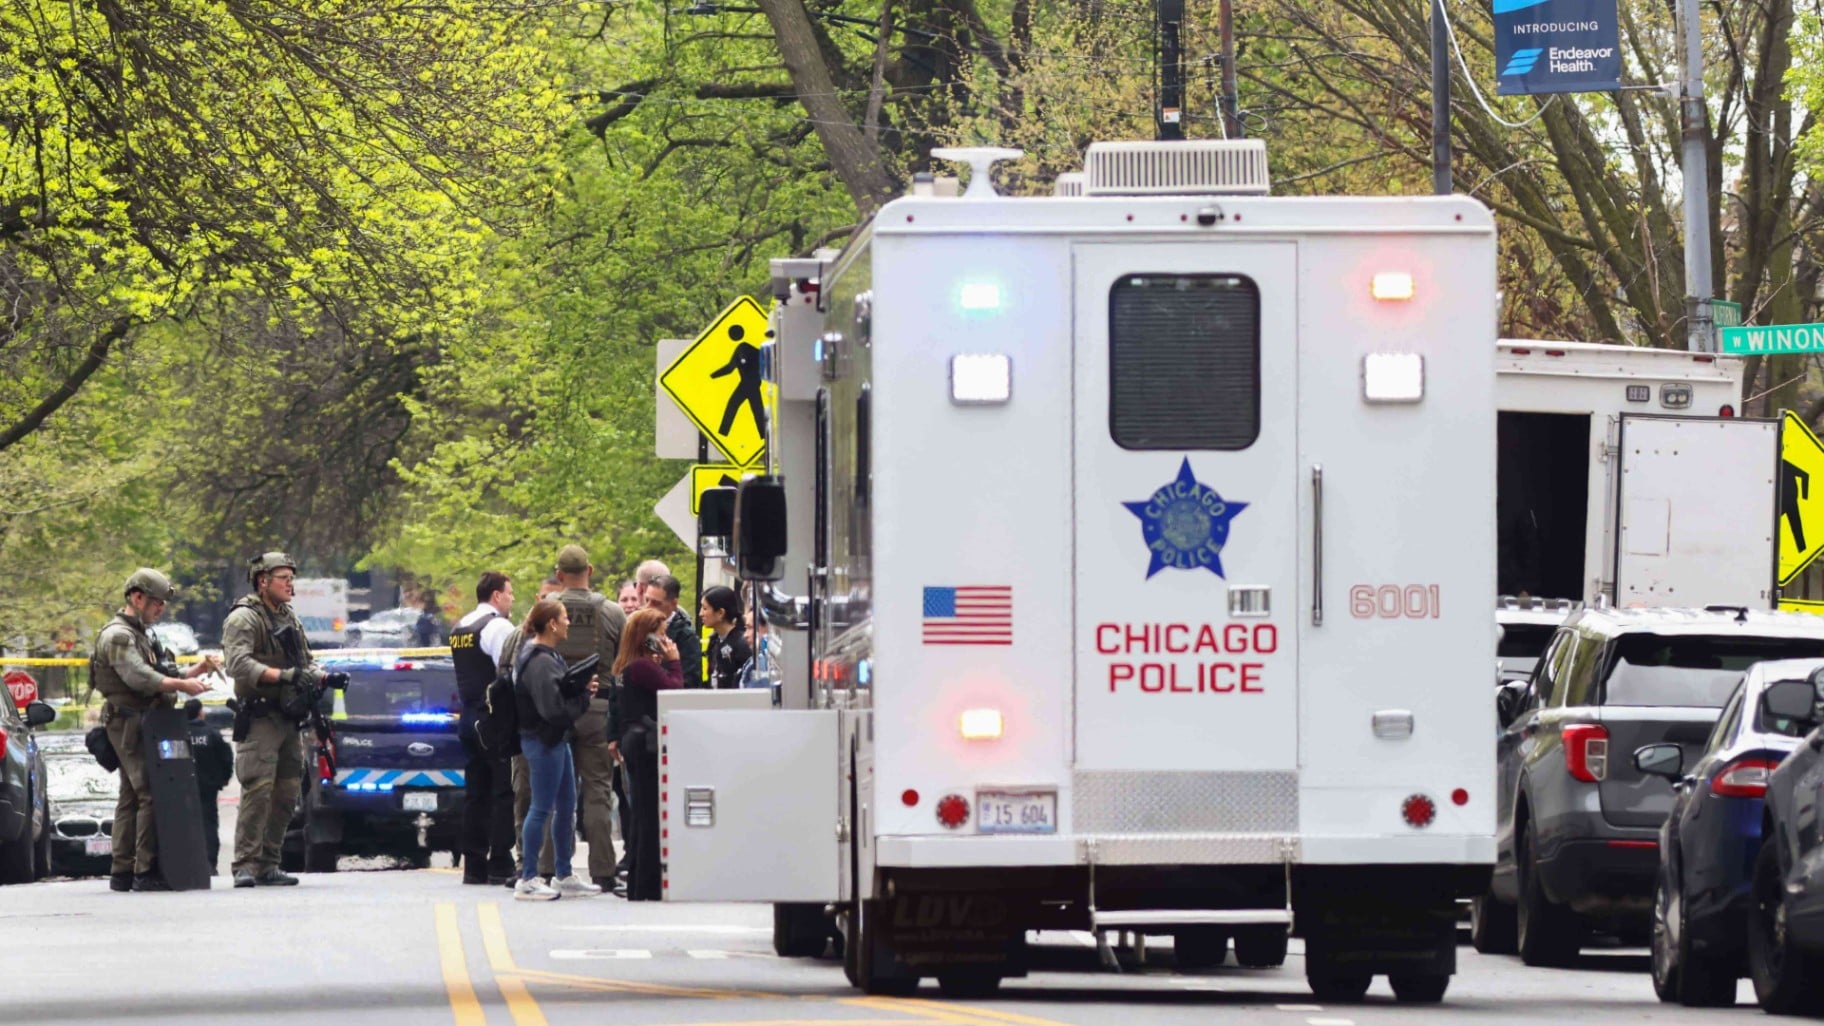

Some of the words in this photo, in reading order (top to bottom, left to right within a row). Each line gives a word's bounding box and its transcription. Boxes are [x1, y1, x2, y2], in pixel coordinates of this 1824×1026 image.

[1513, 21, 1599, 34] INTRODUCING
[1549, 46, 1613, 60] Endeavor
[1550, 60, 1594, 73] Health
[1732, 335, 1742, 348] W
[1145, 481, 1227, 518] CHICAGO
[1149, 538, 1222, 568] POLICE
[1349, 584, 1440, 619] 6001
[1096, 624, 1278, 654] CHICAGO
[1109, 662, 1265, 693] POLICE
[7, 682, 36, 701] TOP
[995, 804, 1013, 825] 15
